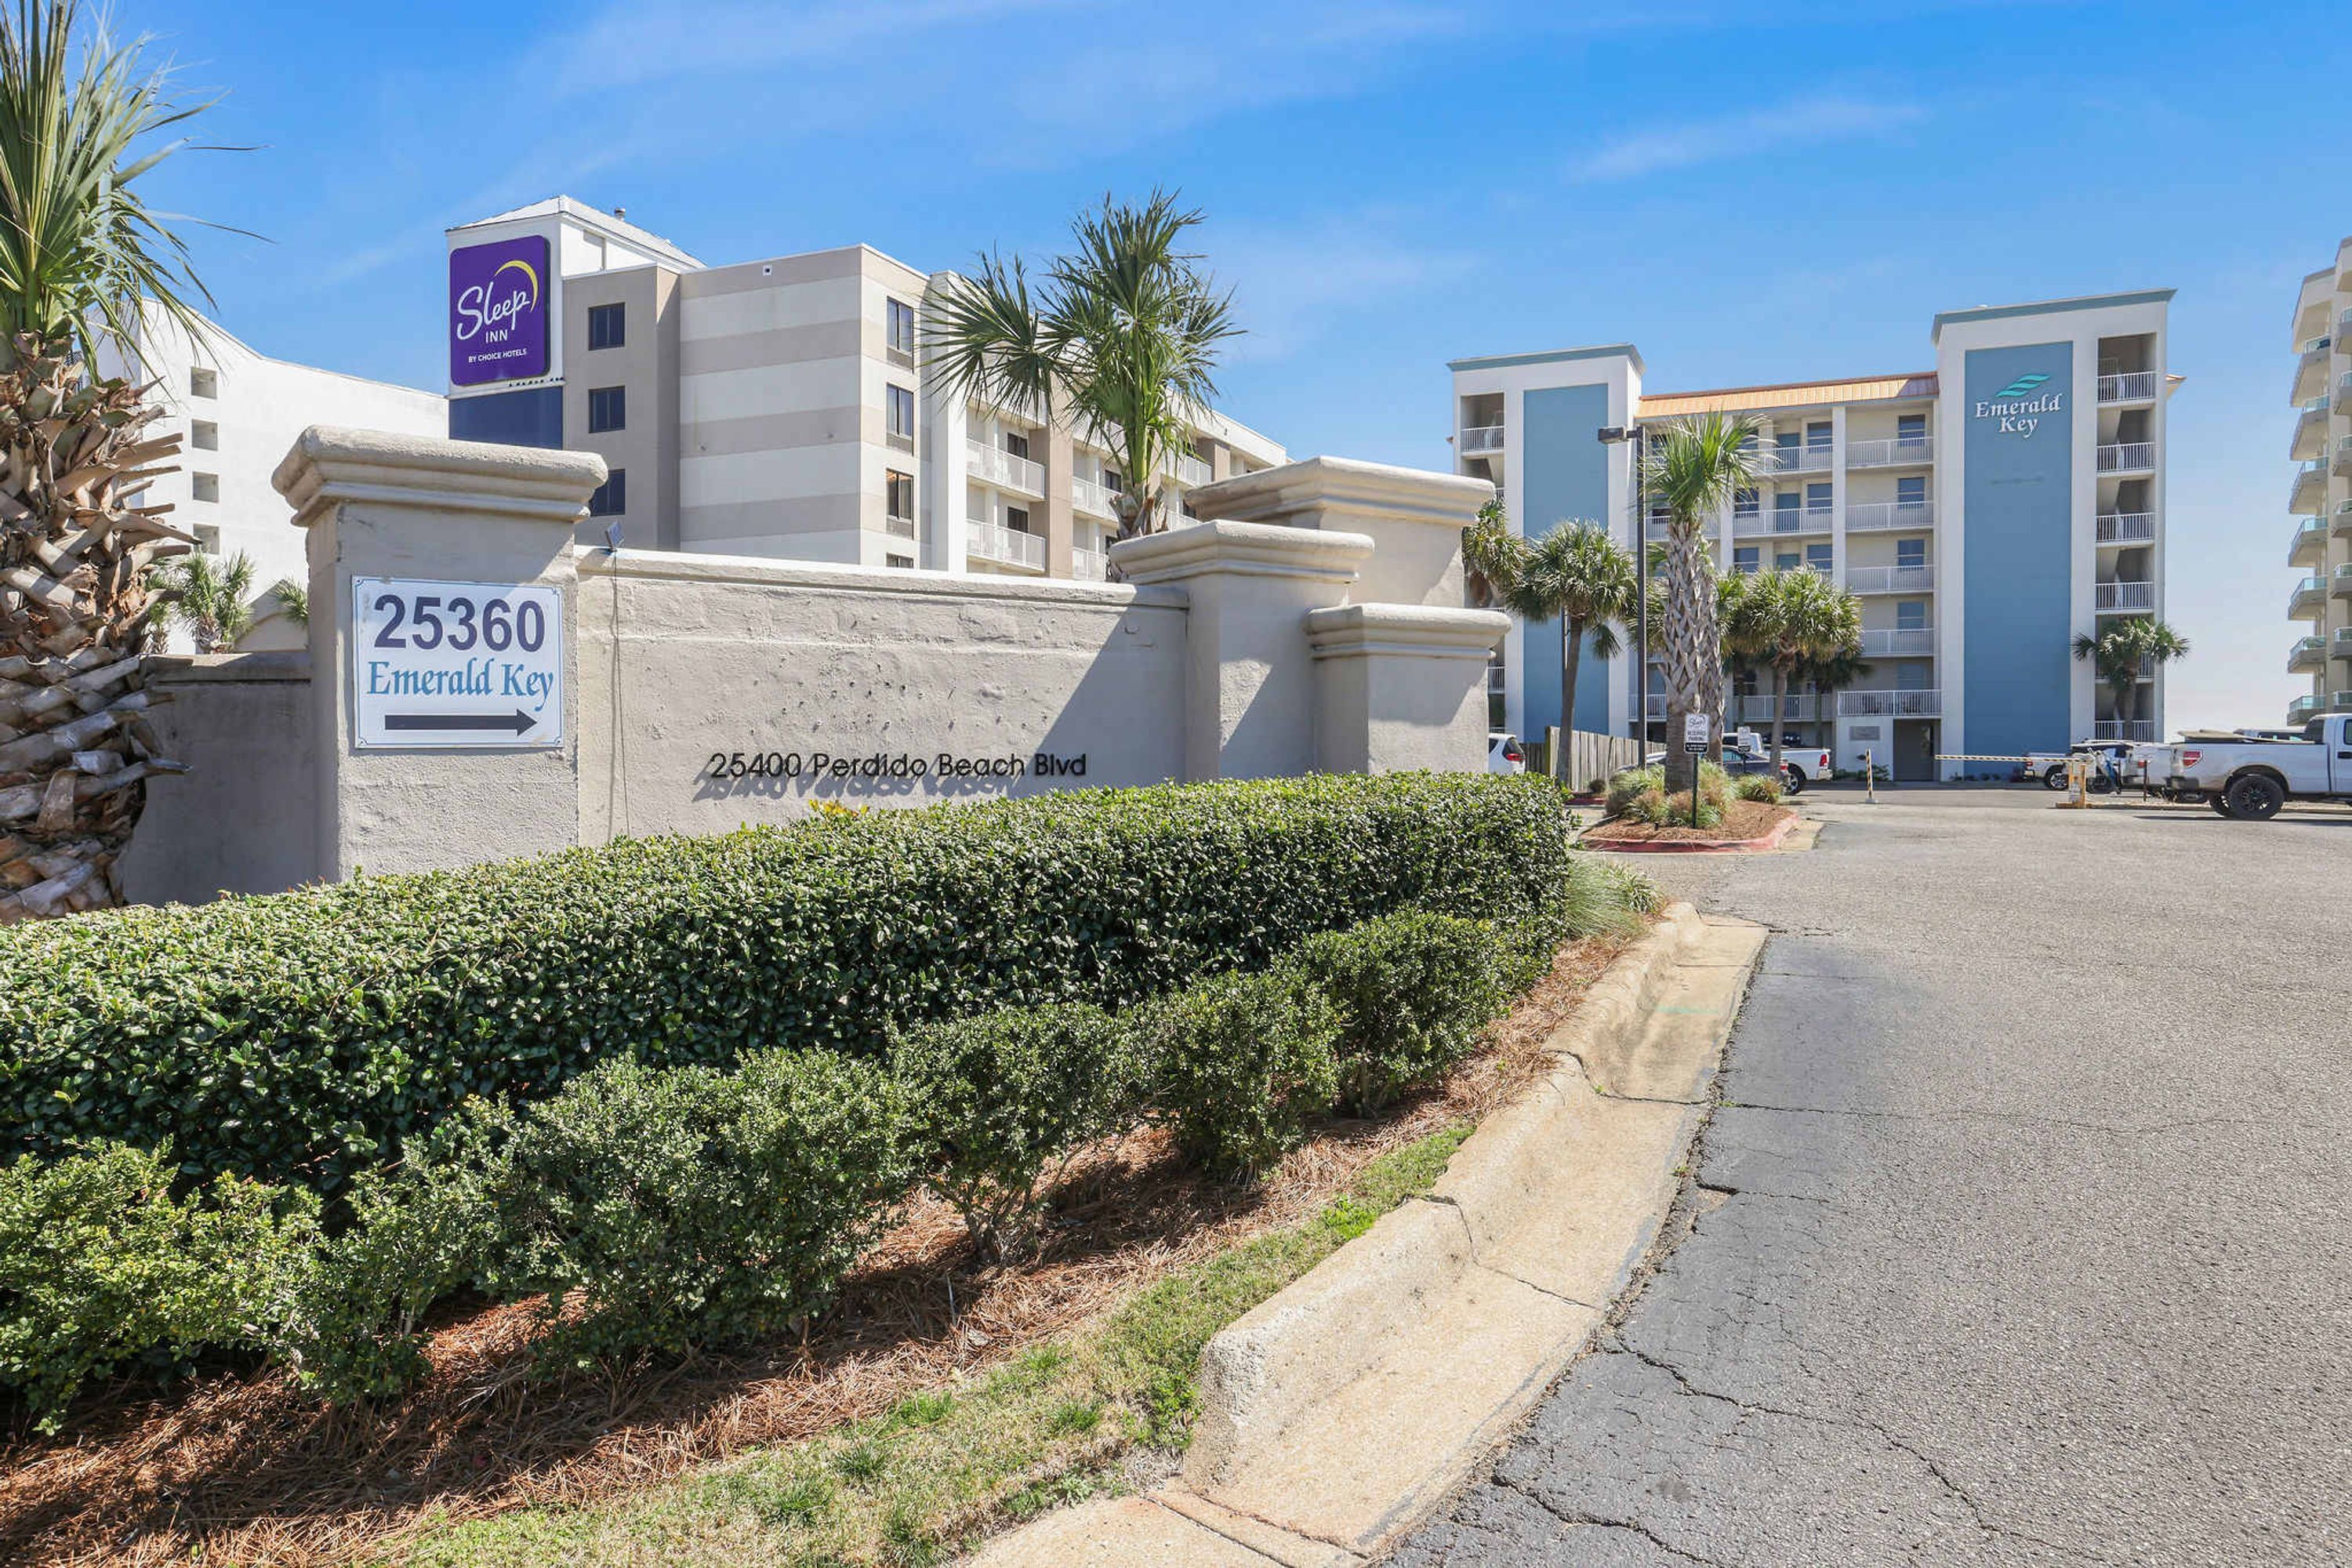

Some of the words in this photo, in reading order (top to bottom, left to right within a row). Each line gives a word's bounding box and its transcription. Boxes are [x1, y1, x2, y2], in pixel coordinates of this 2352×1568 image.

[457, 281, 530, 339] Sleep
[485, 329, 508, 343] INN
[478, 352, 502, 361] CHOICE
[503, 348, 527, 358] HOTELS
[1975, 393, 2063, 418] Emerald
[1999, 416, 2038, 438] Key
[374, 594, 545, 652] 25360
[367, 657, 495, 696] Emerald
[500, 663, 554, 712] Key
[710, 753, 801, 779] 25400
[814, 752, 927, 778] Perdido
[938, 753, 1025, 777] Beach
[1035, 753, 1086, 776] Blvd
